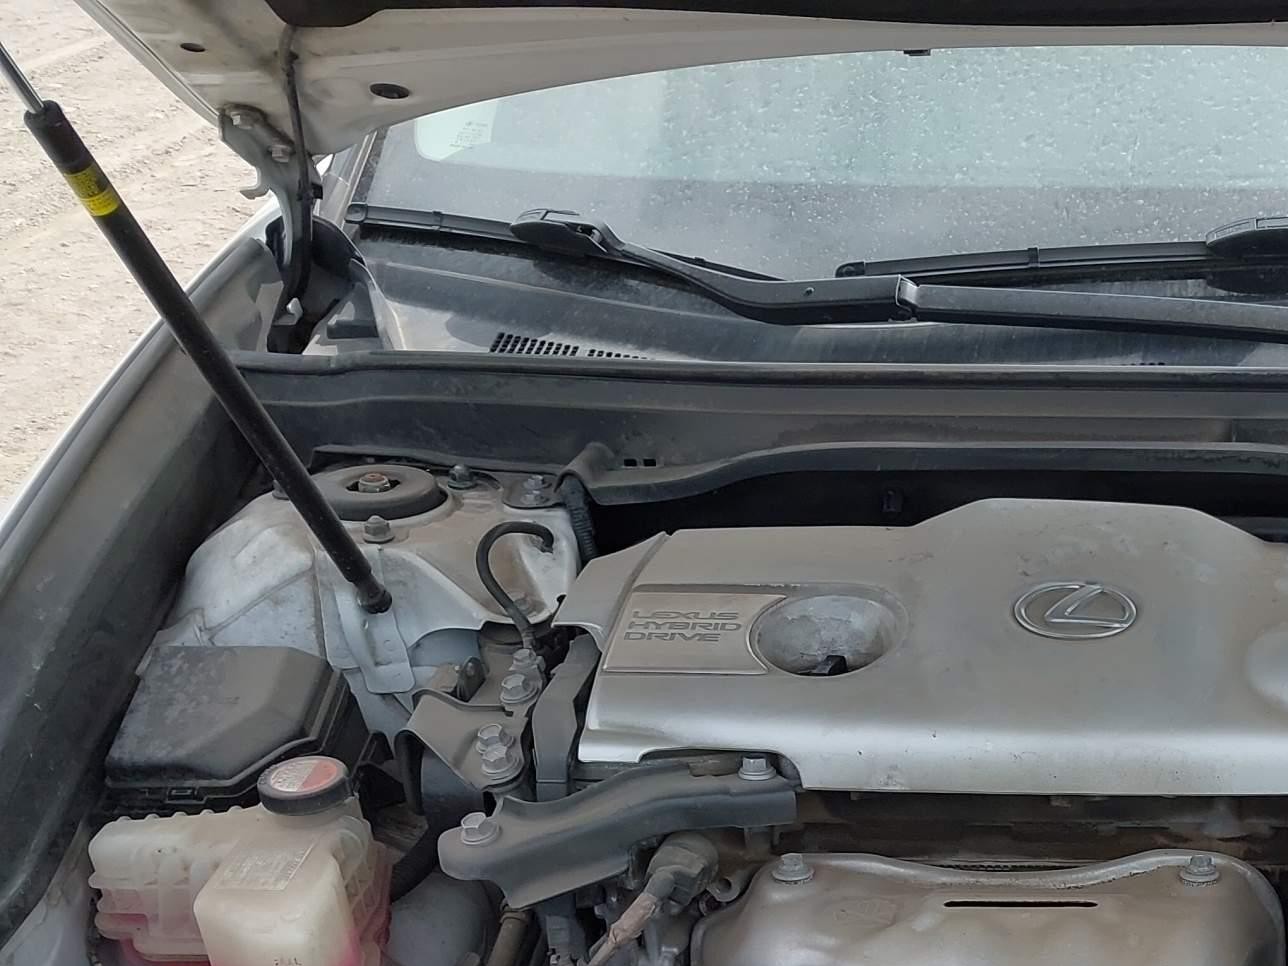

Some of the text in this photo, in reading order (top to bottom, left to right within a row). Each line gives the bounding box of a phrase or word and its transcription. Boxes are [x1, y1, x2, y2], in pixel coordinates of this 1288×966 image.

[632, 611, 740, 620] LEXUS
[628, 621, 742, 631] HYBRID
[623, 631, 721, 642] DRIVE
